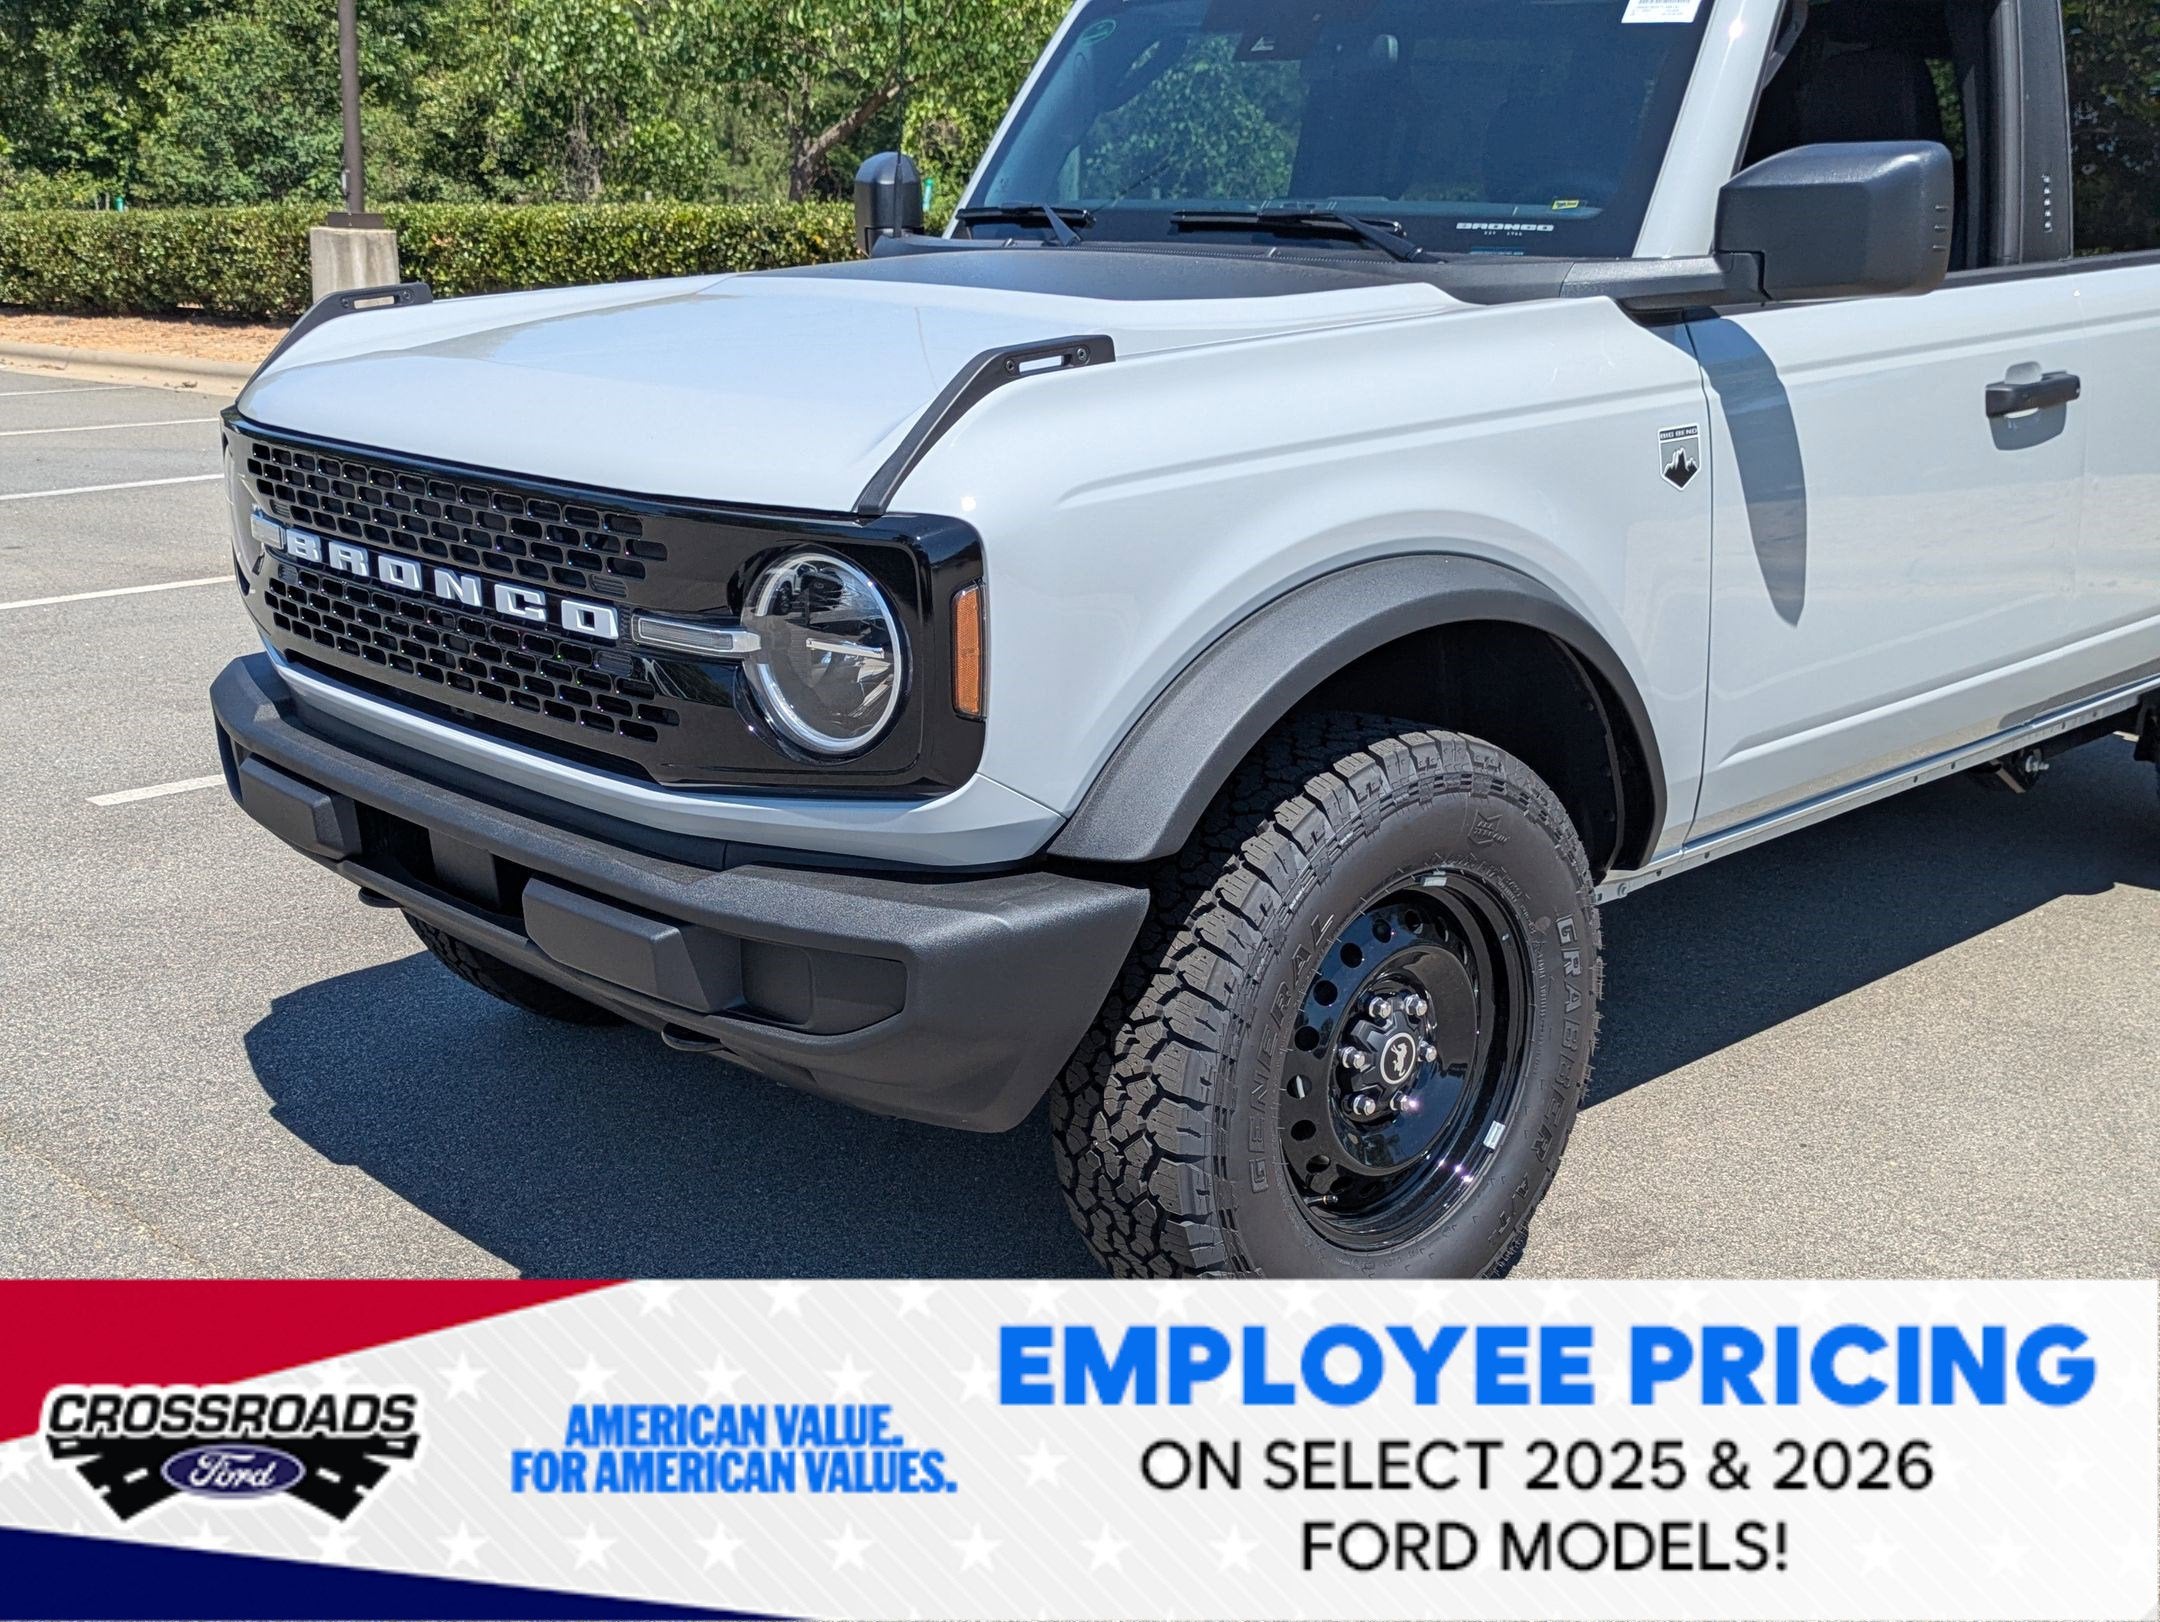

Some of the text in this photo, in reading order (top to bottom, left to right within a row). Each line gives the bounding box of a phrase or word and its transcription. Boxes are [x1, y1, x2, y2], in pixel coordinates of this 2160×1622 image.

[1456, 222, 1554, 231] BRONCO
[286, 528, 620, 640] BRONCO
[1248, 914, 1335, 1193] GENERAL
[1530, 914, 1581, 1163] GRABBER
